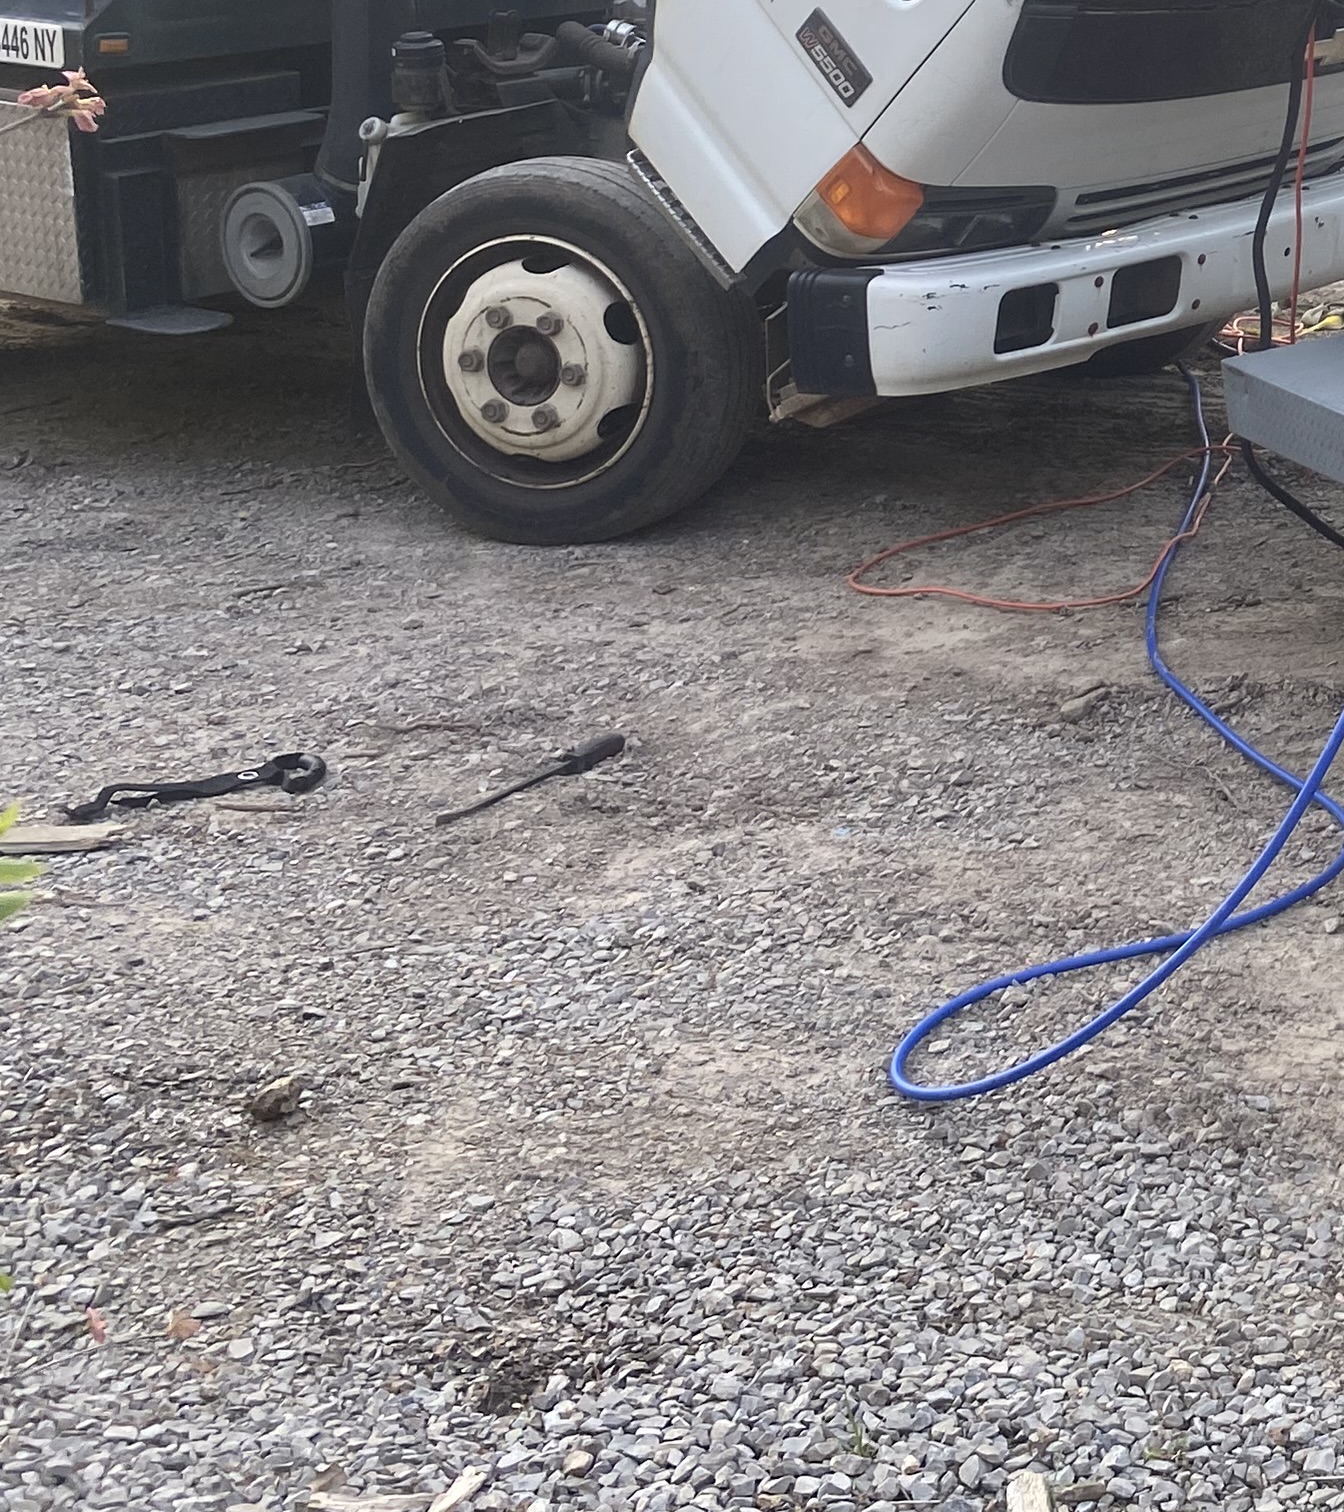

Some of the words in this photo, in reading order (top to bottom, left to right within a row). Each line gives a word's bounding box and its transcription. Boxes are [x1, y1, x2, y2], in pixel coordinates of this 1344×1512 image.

[0, 23, 29, 60] 446
[34, 27, 57, 63] NY
[799, 26, 855, 98] W5500
[818, 24, 858, 76] GMC
